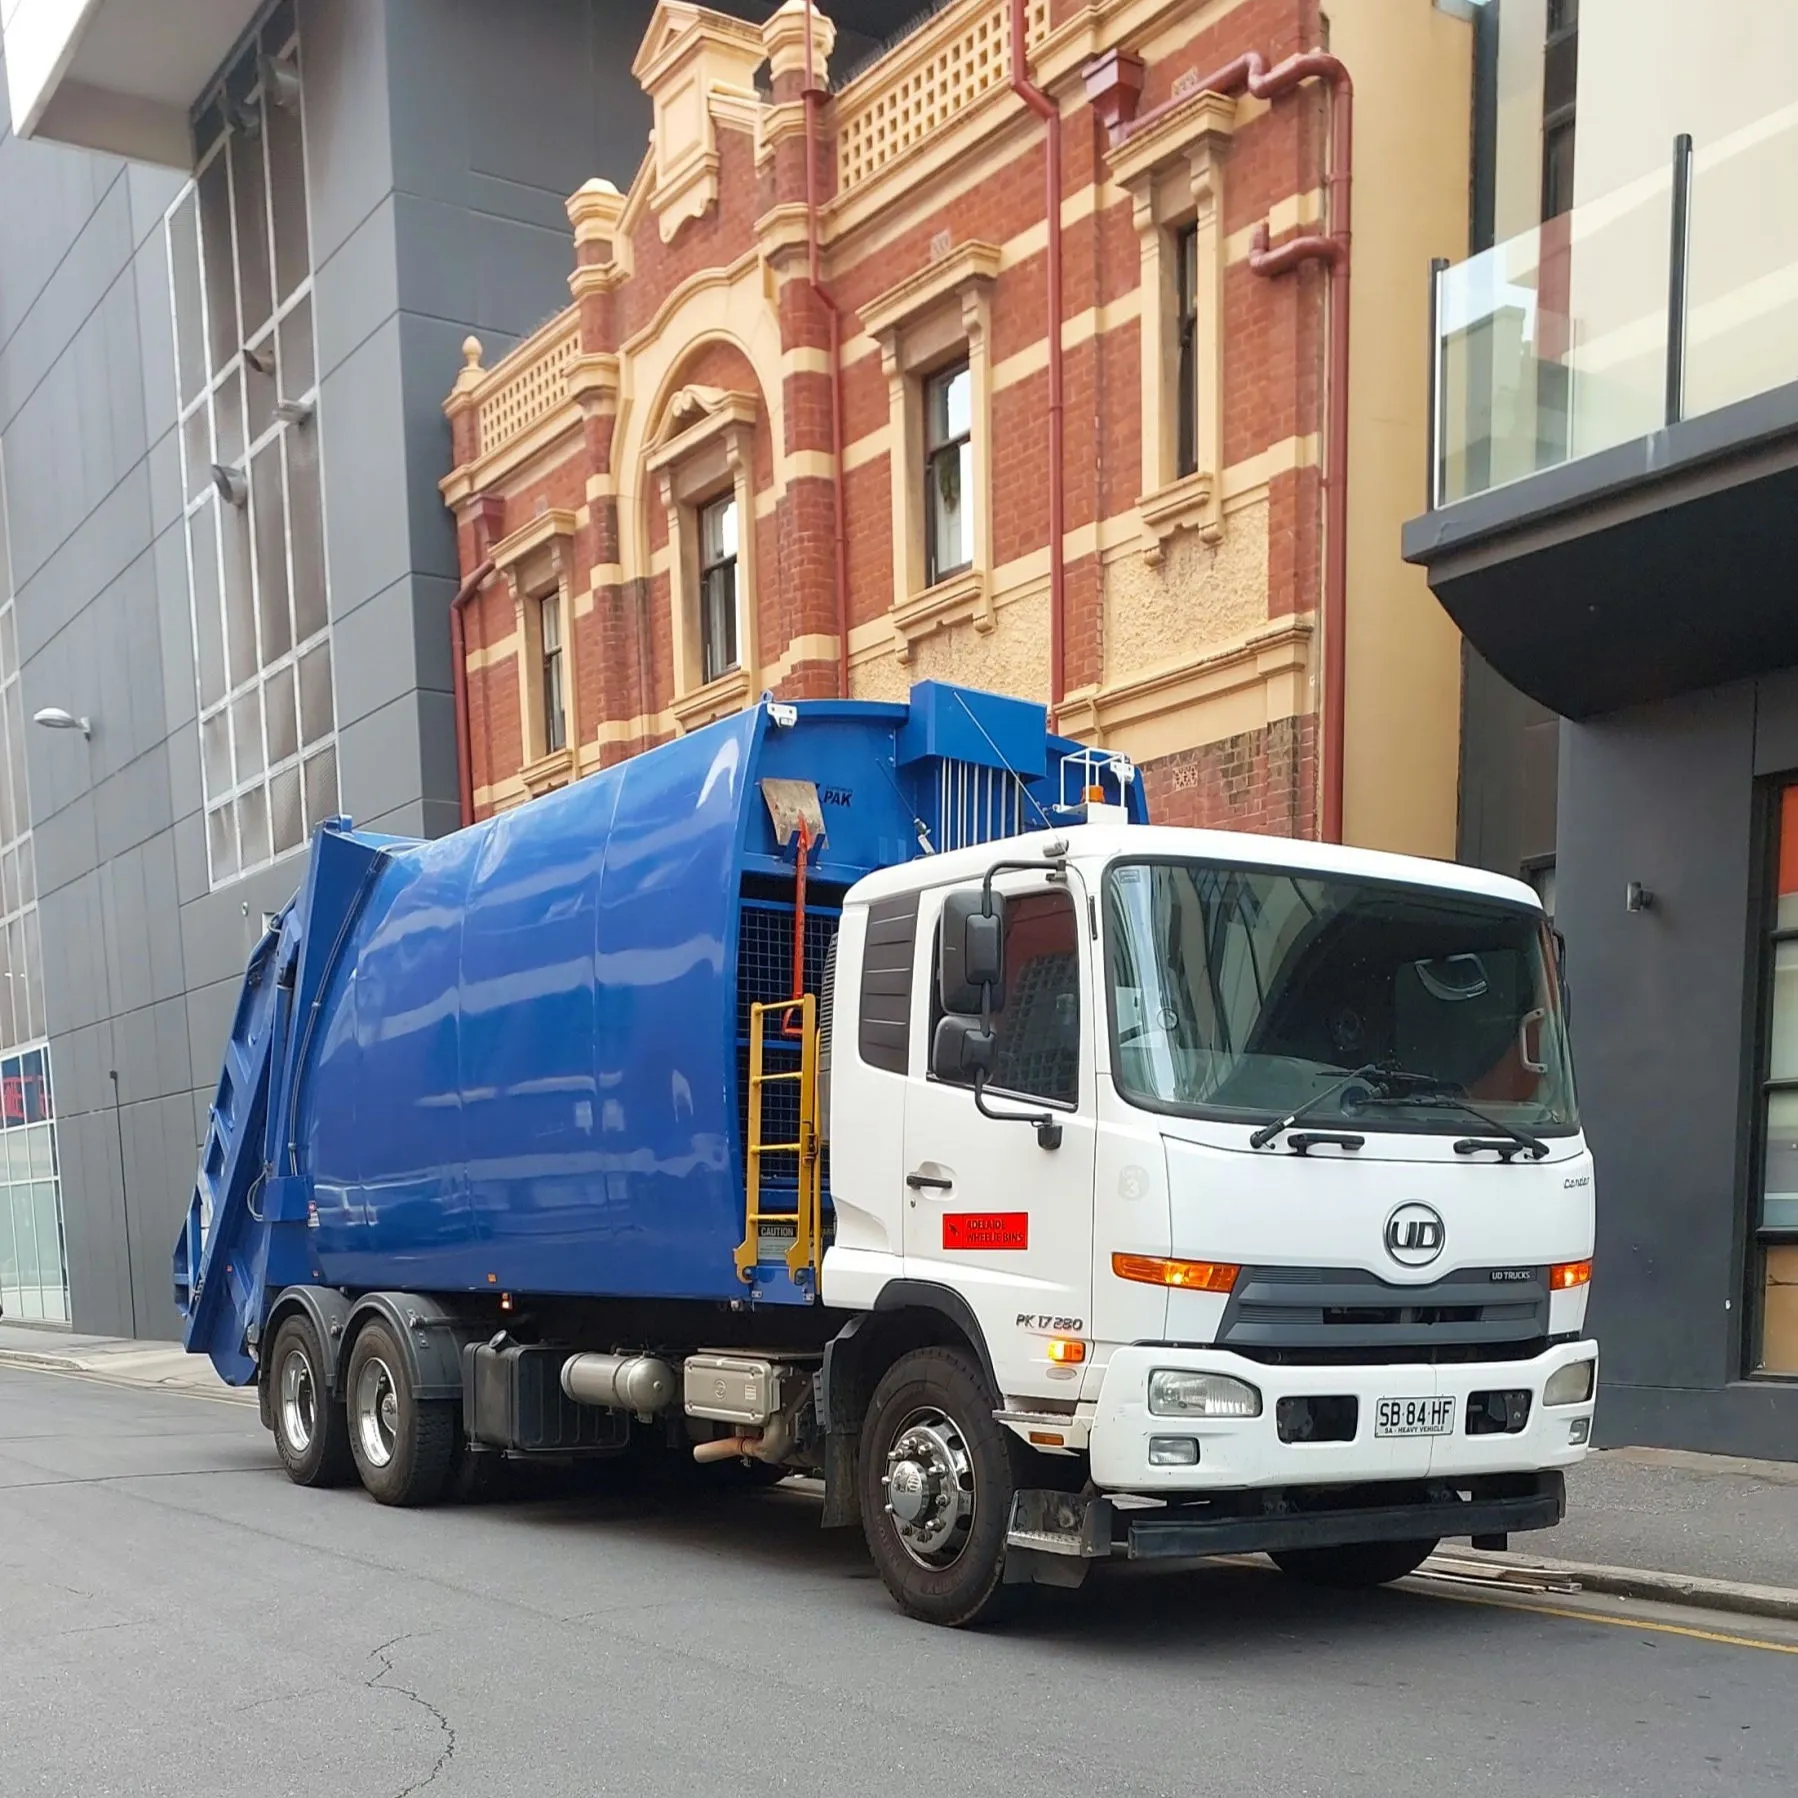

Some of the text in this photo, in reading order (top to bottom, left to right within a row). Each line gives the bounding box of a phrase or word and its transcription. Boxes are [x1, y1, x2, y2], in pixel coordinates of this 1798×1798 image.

[761, 1227, 794, 1236] CAUTION
[1388, 1221, 1443, 1249] UD
[1003, 1232, 1024, 1243] BINS
[1491, 1271, 1531, 1280] UD TRUCKS
[1016, 1313, 1036, 1328] PK
[1053, 1316, 1083, 1331] 280
[1398, 1426, 1418, 1434] HEAVY
[1420, 1425, 1444, 1433] VEHICLE
